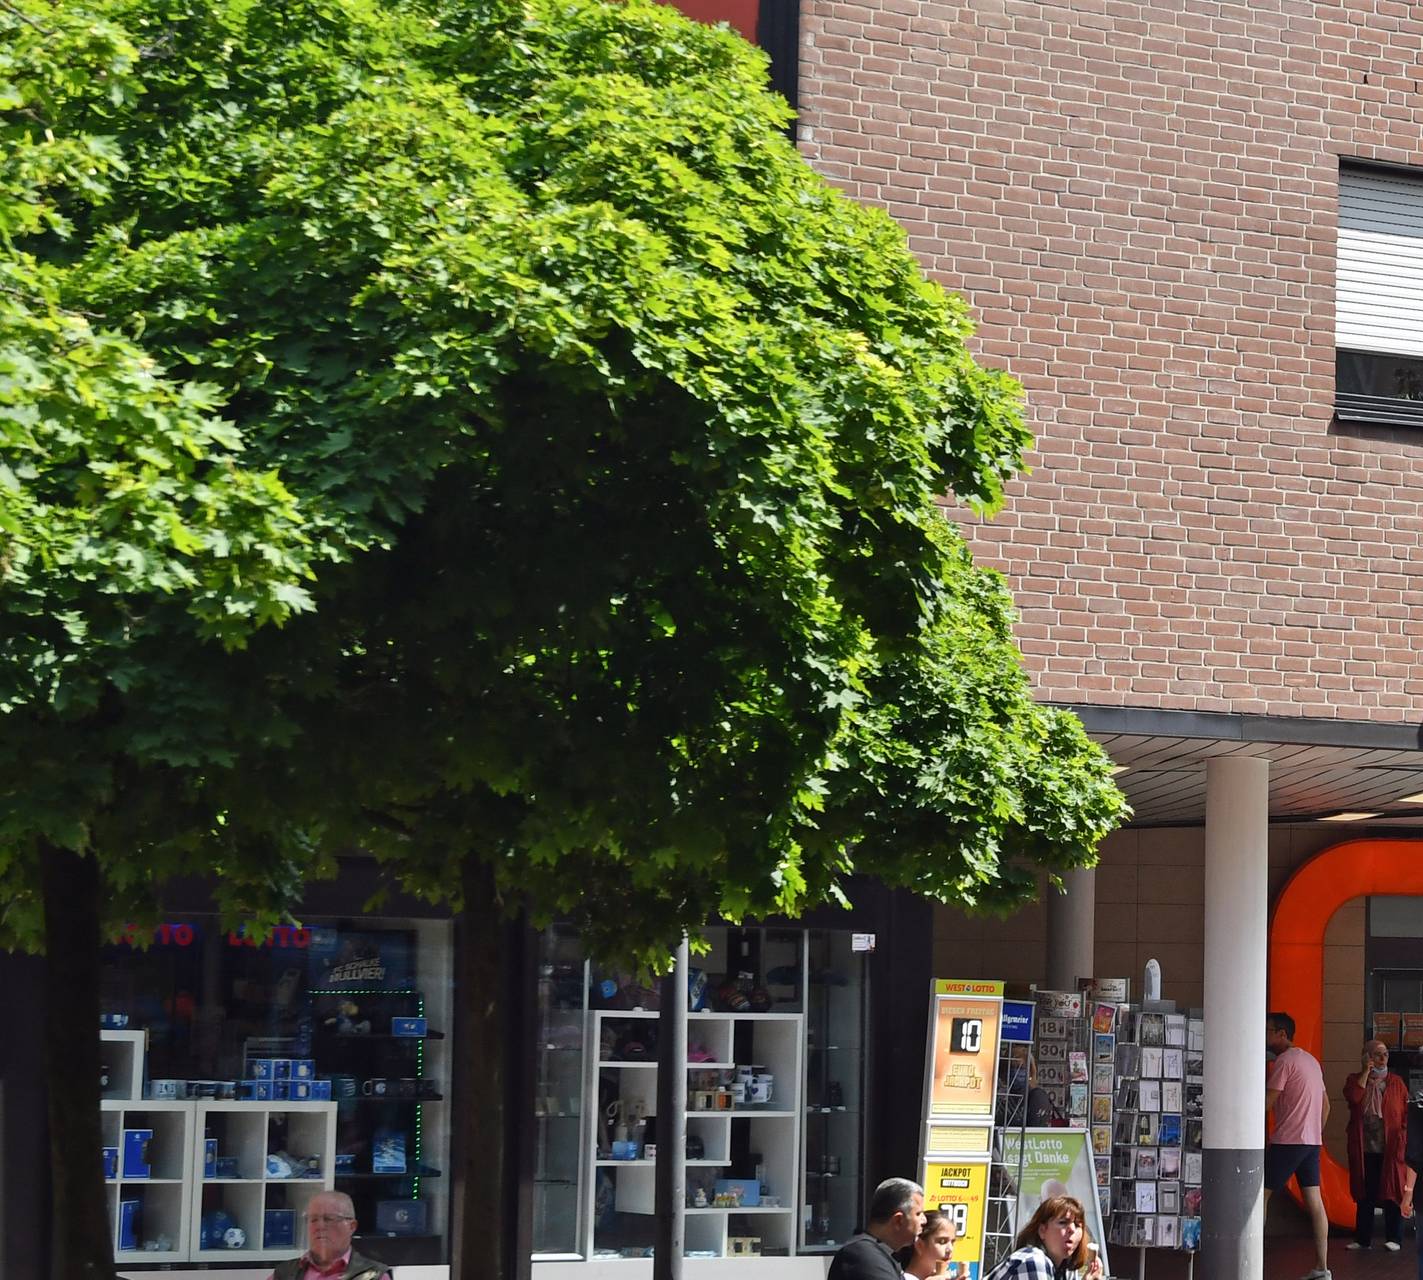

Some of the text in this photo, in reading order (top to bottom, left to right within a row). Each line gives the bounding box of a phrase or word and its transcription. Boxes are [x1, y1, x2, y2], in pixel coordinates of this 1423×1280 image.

[945, 984, 995, 993] WEST LOTTO
[1040, 1022, 1057, 1034] 18
[961, 1020, 982, 1052] 10
[1041, 1045, 1059, 1056] 30
[1005, 1137, 1063, 1150] WestLotto
[1035, 1151, 1069, 1164] Danke
[941, 1168, 971, 1177] JACKPOT
